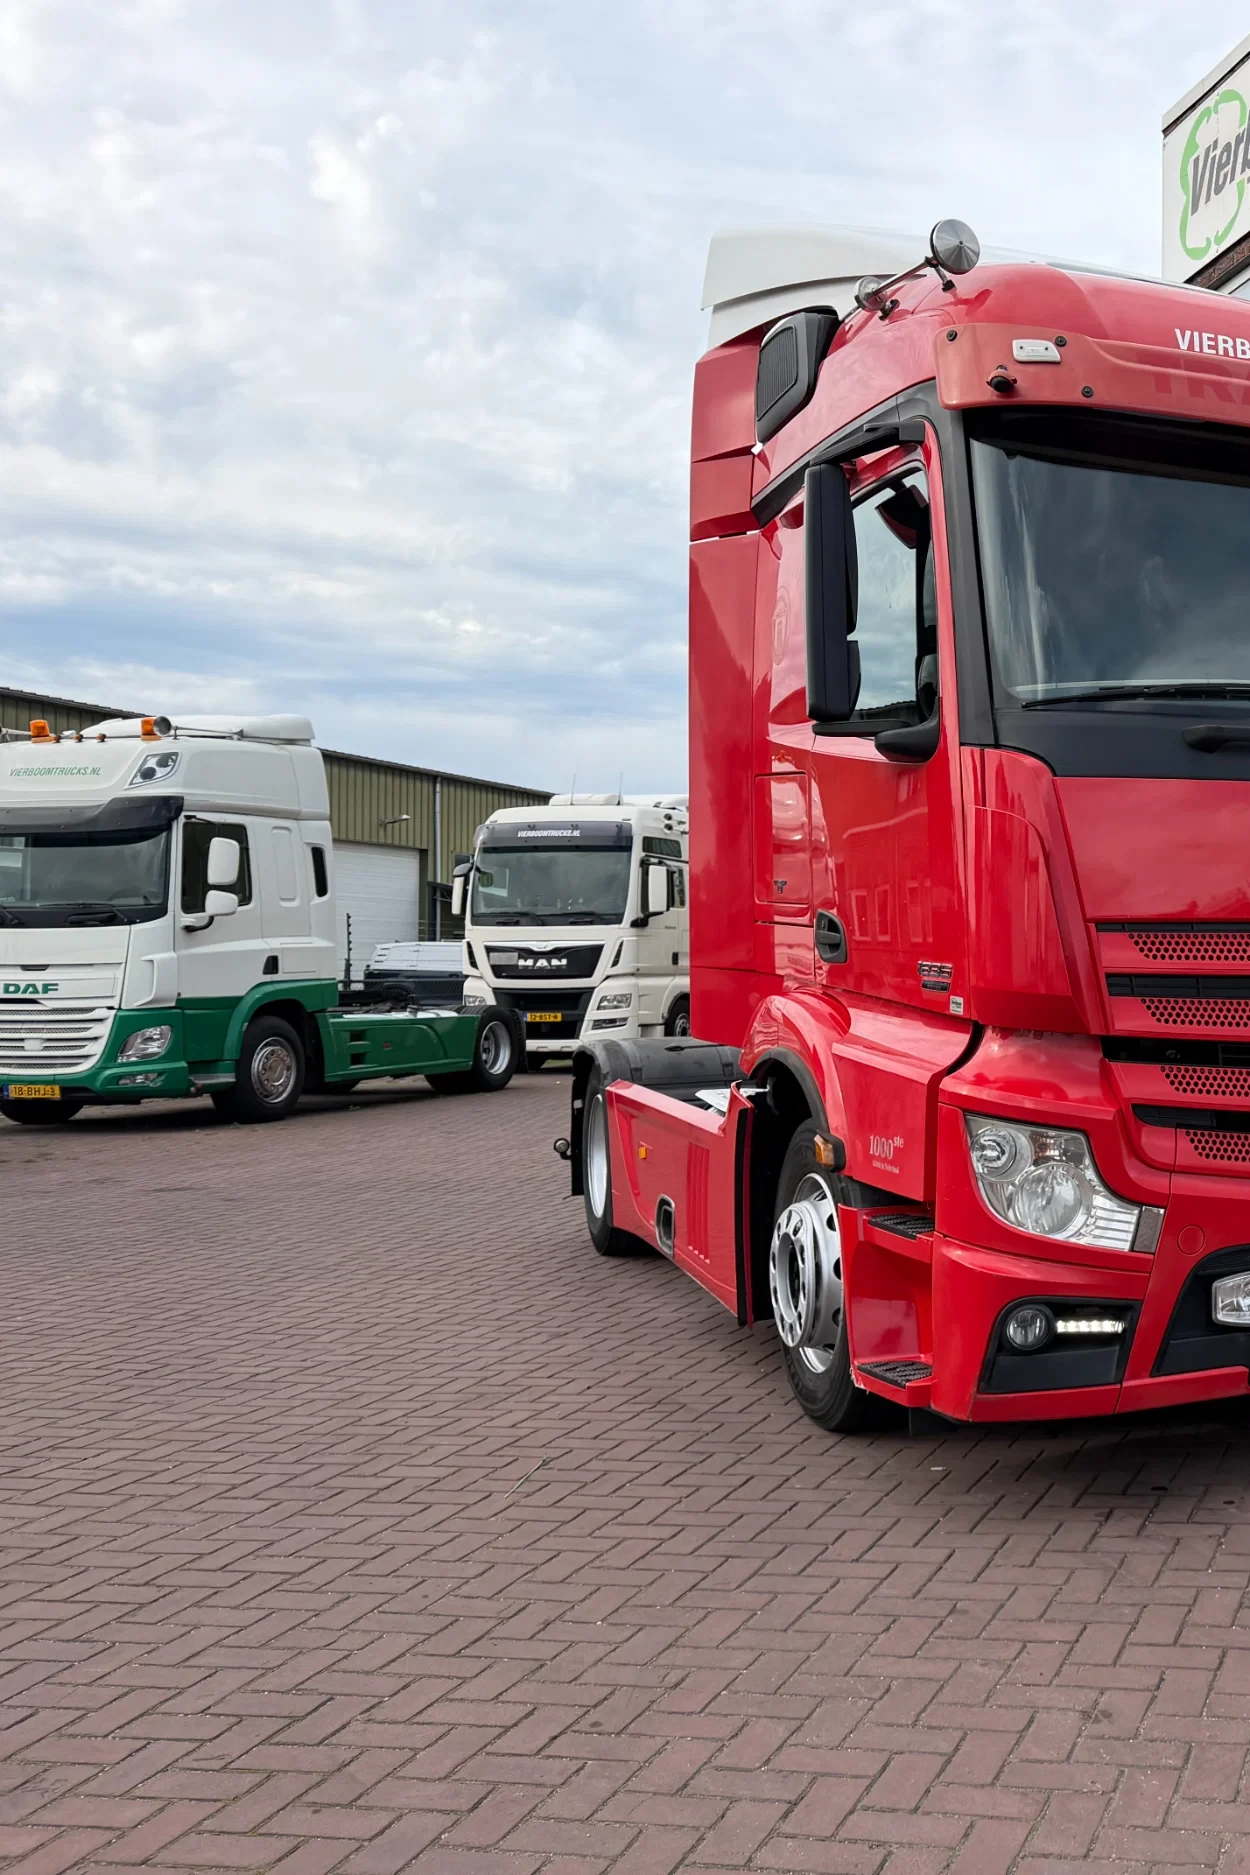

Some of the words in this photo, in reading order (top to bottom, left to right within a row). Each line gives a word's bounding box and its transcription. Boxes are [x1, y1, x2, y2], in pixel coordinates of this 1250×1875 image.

[10, 766, 102, 777] VIERBOOMTRUCKS.NL
[517, 829, 581, 838] VIERBOOMTRUCKS.NL
[518, 958, 568, 969] MAN
[3, 983, 59, 994] DAF
[13, 1086, 56, 1096] 18-BHJ-3
